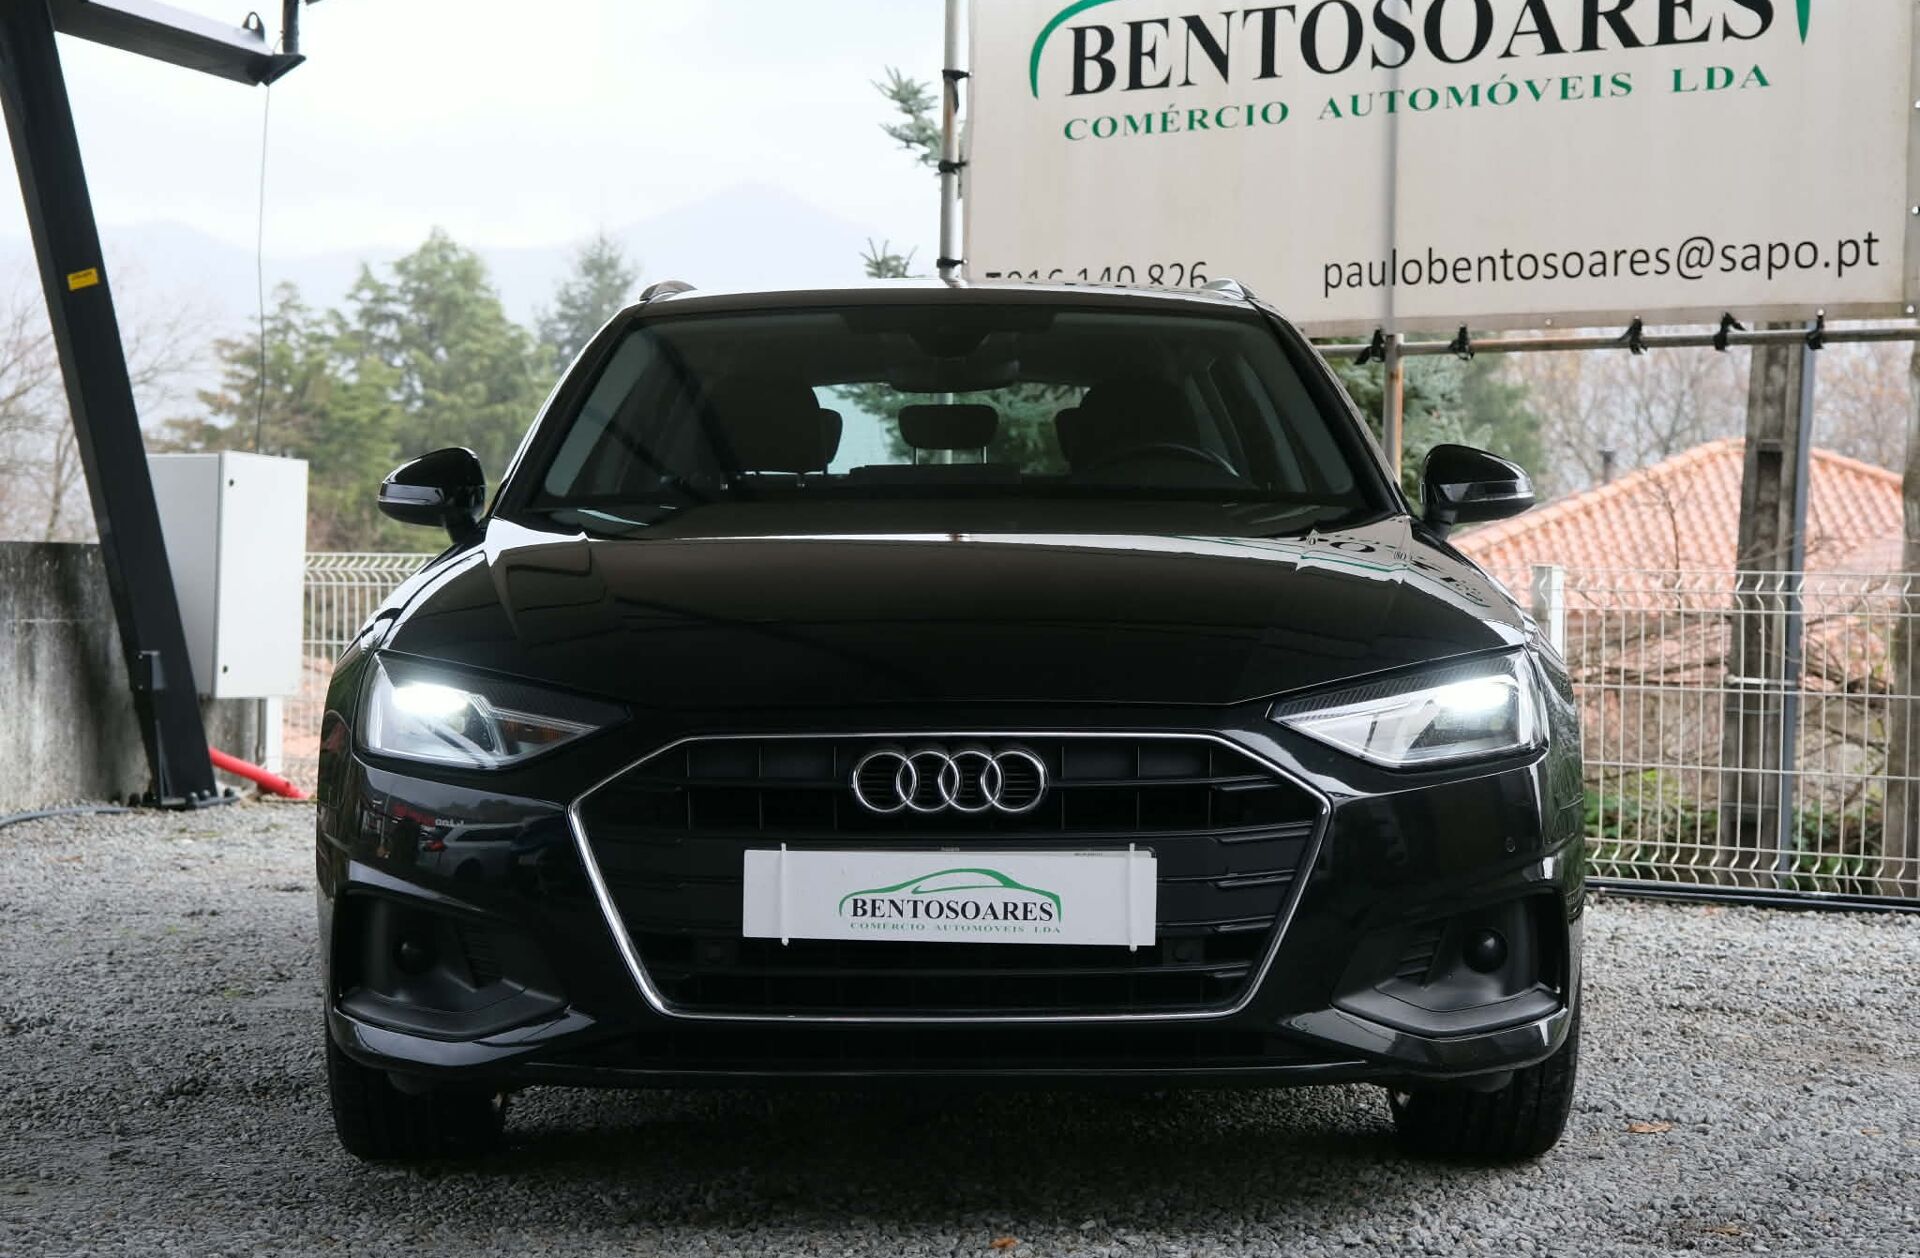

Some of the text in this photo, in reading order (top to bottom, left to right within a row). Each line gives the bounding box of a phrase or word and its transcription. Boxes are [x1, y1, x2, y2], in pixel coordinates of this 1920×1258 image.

[1064, 64, 1772, 141] COMÉRCIO AUTOMÓVEIS LDA
[1323, 230, 1880, 297] paulobentosoares@sapo.pt
[851, 898, 1053, 922] BENTOSOARES
